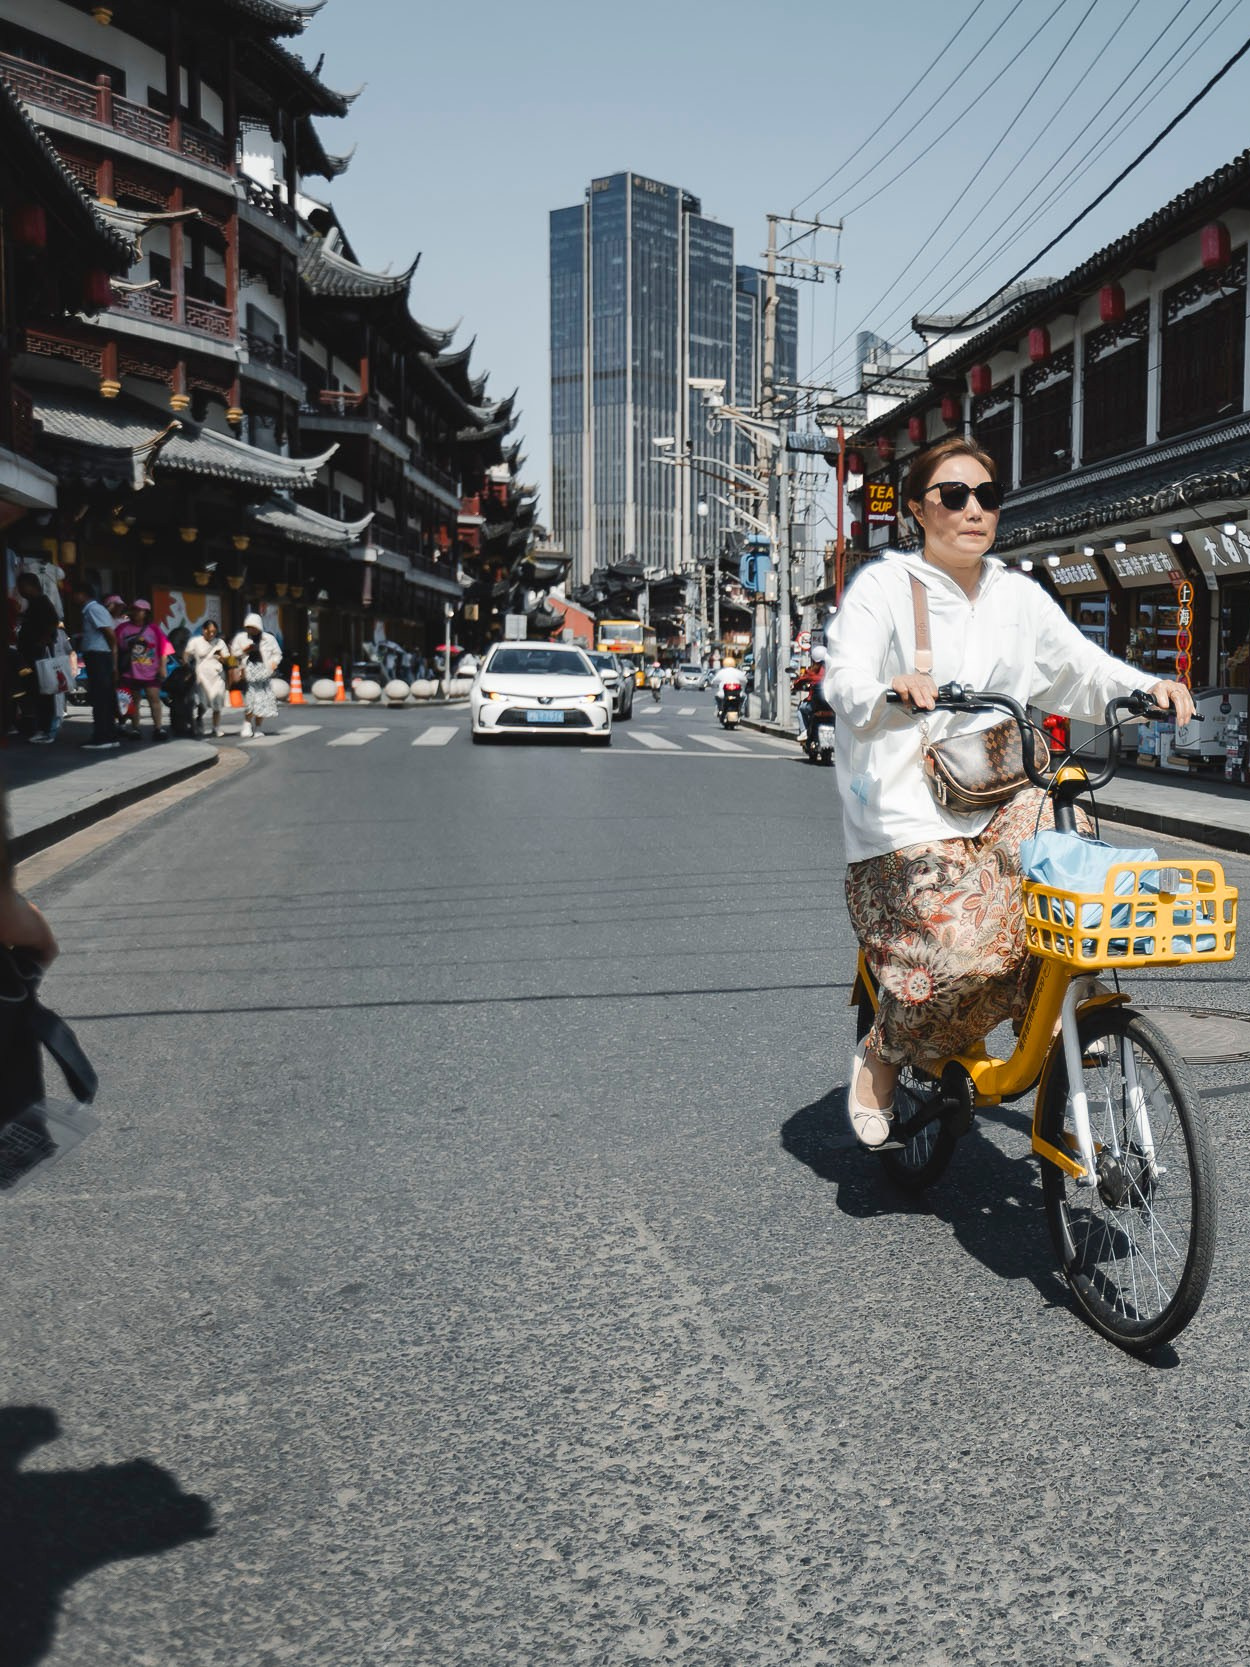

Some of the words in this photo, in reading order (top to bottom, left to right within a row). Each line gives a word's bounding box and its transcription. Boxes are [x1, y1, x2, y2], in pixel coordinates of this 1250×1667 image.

[869, 485, 895, 500] TEA
[871, 500, 893, 513] CUP
[1114, 552, 1175, 578] 上海特产超市
